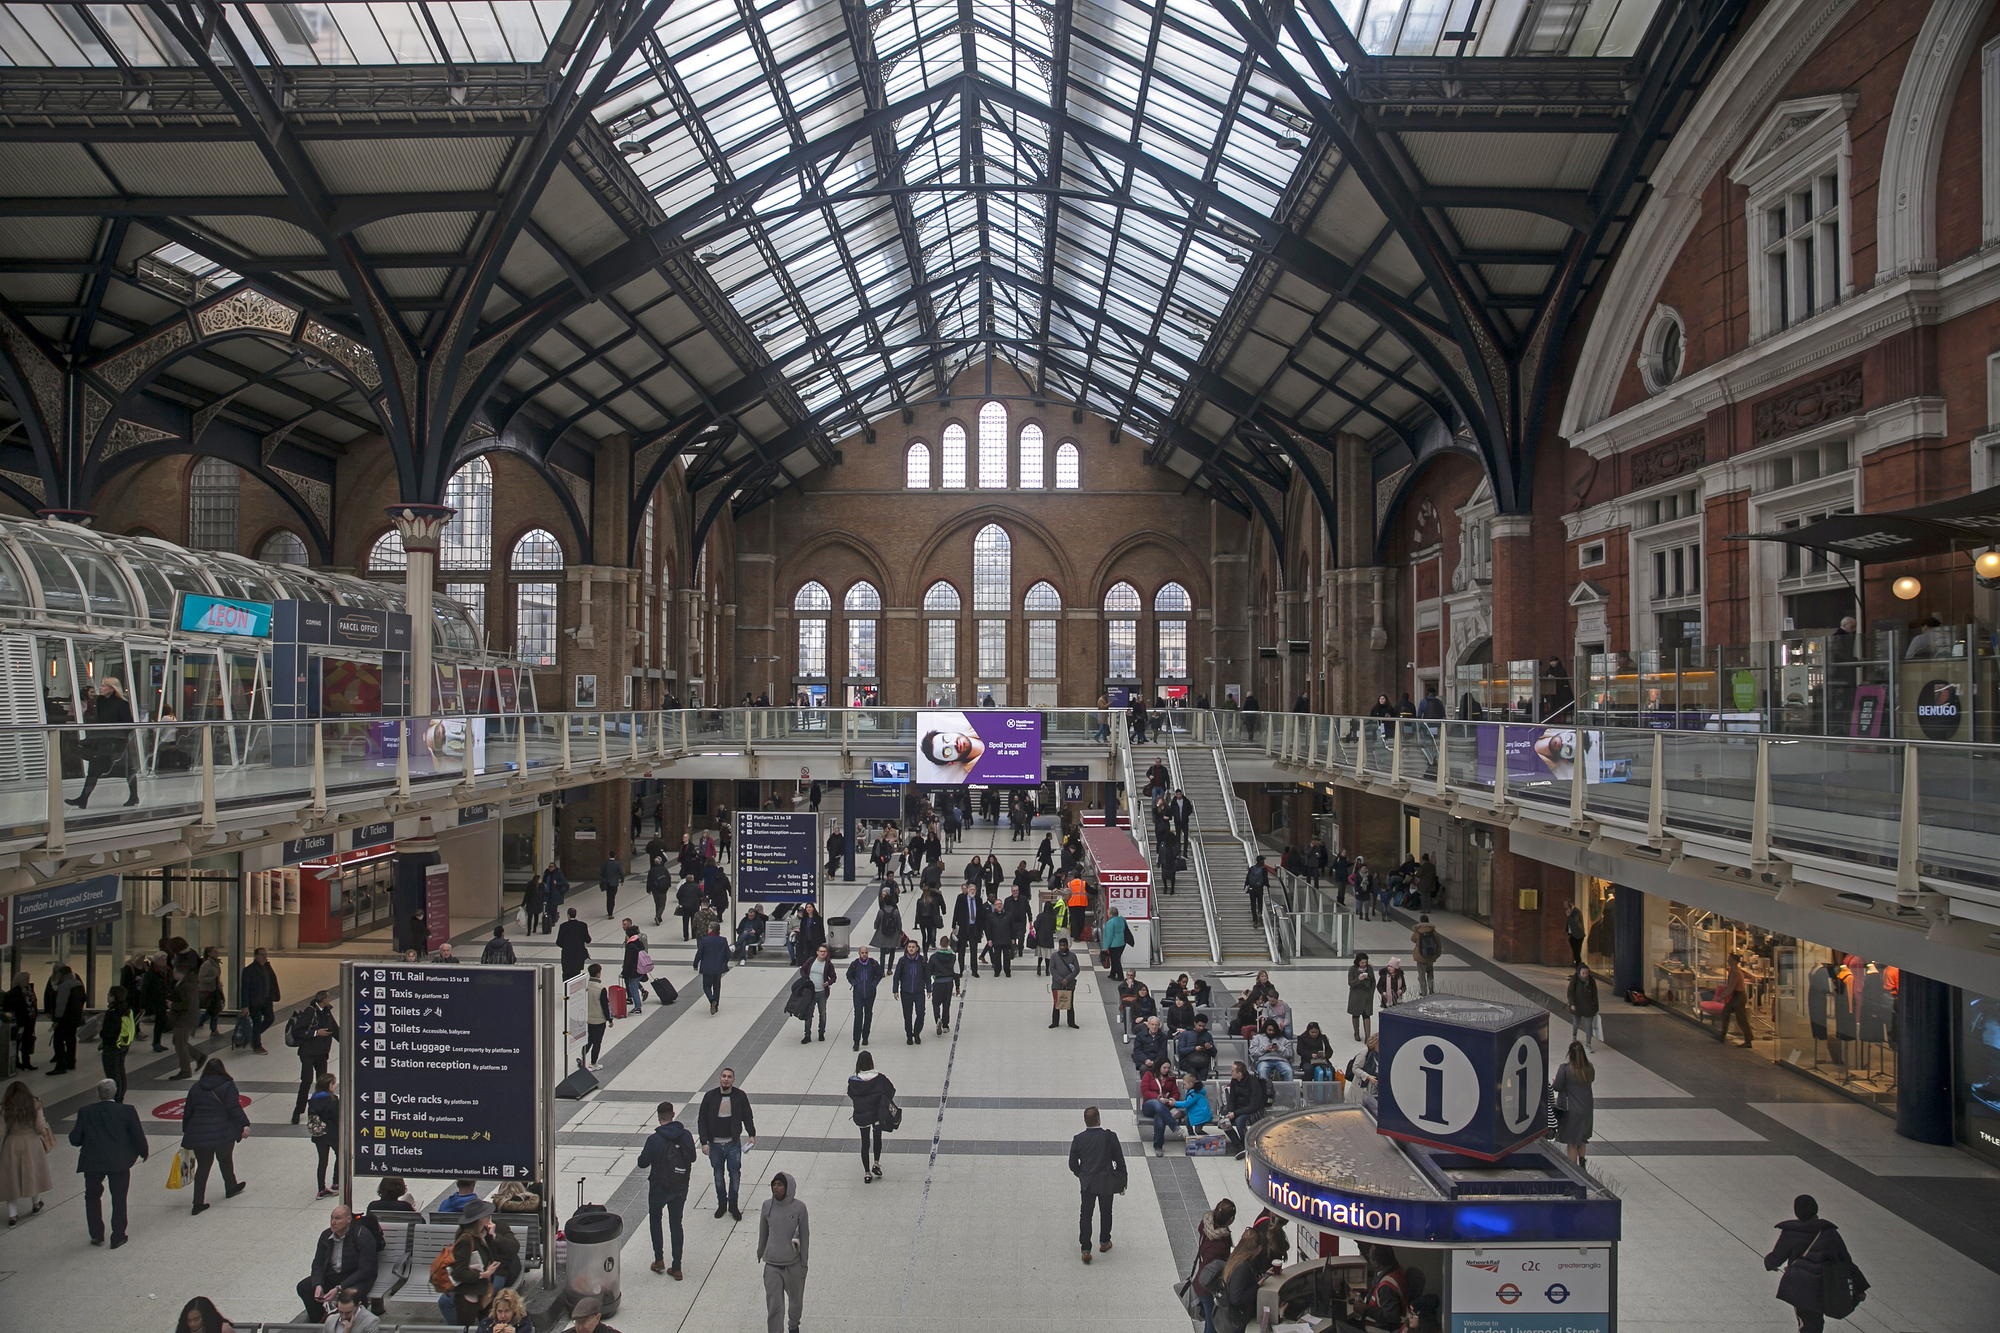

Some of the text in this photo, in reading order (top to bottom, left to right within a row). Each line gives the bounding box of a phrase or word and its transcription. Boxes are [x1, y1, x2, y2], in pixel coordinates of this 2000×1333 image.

[208, 603, 249, 629] LEON
[340, 622, 378, 633] PARCEL OFFICE
[1919, 705, 1956, 716] BENUGO
[988, 741, 1027, 749] Spoil yourself
[471, 806, 484, 815] Tickets
[370, 824, 387, 835] Tickets
[304, 836, 326, 849] Tickets
[1109, 874, 1134, 882] Tickets
[19, 889, 104, 915] London Liverpool Street
[20, 892, 42, 903] Welcome
[390, 972, 405, 981] TfL
[408, 972, 424, 981] Rail
[390, 988, 413, 998] Taxis
[390, 1006, 421, 1016] Toilets
[390, 1024, 421, 1033] Toilets
[390, 1041, 409, 1050] Left
[411, 1041, 451, 1053] Luggage
[390, 1058, 425, 1068] Station
[427, 1058, 471, 1071] reception
[390, 1093, 416, 1105] Cycle
[418, 1094, 442, 1104] racks
[390, 1111, 410, 1121] First
[413, 1111, 427, 1121] aid
[390, 1129, 410, 1140] Way
[412, 1129, 428, 1139] out
[390, 1146, 423, 1156] Tickets
[483, 1166, 498, 1175] Lift
[1267, 1174, 1401, 1232] information
[1521, 1260, 1541, 1272] c2c
[1558, 1262, 1601, 1270] greateranglia
